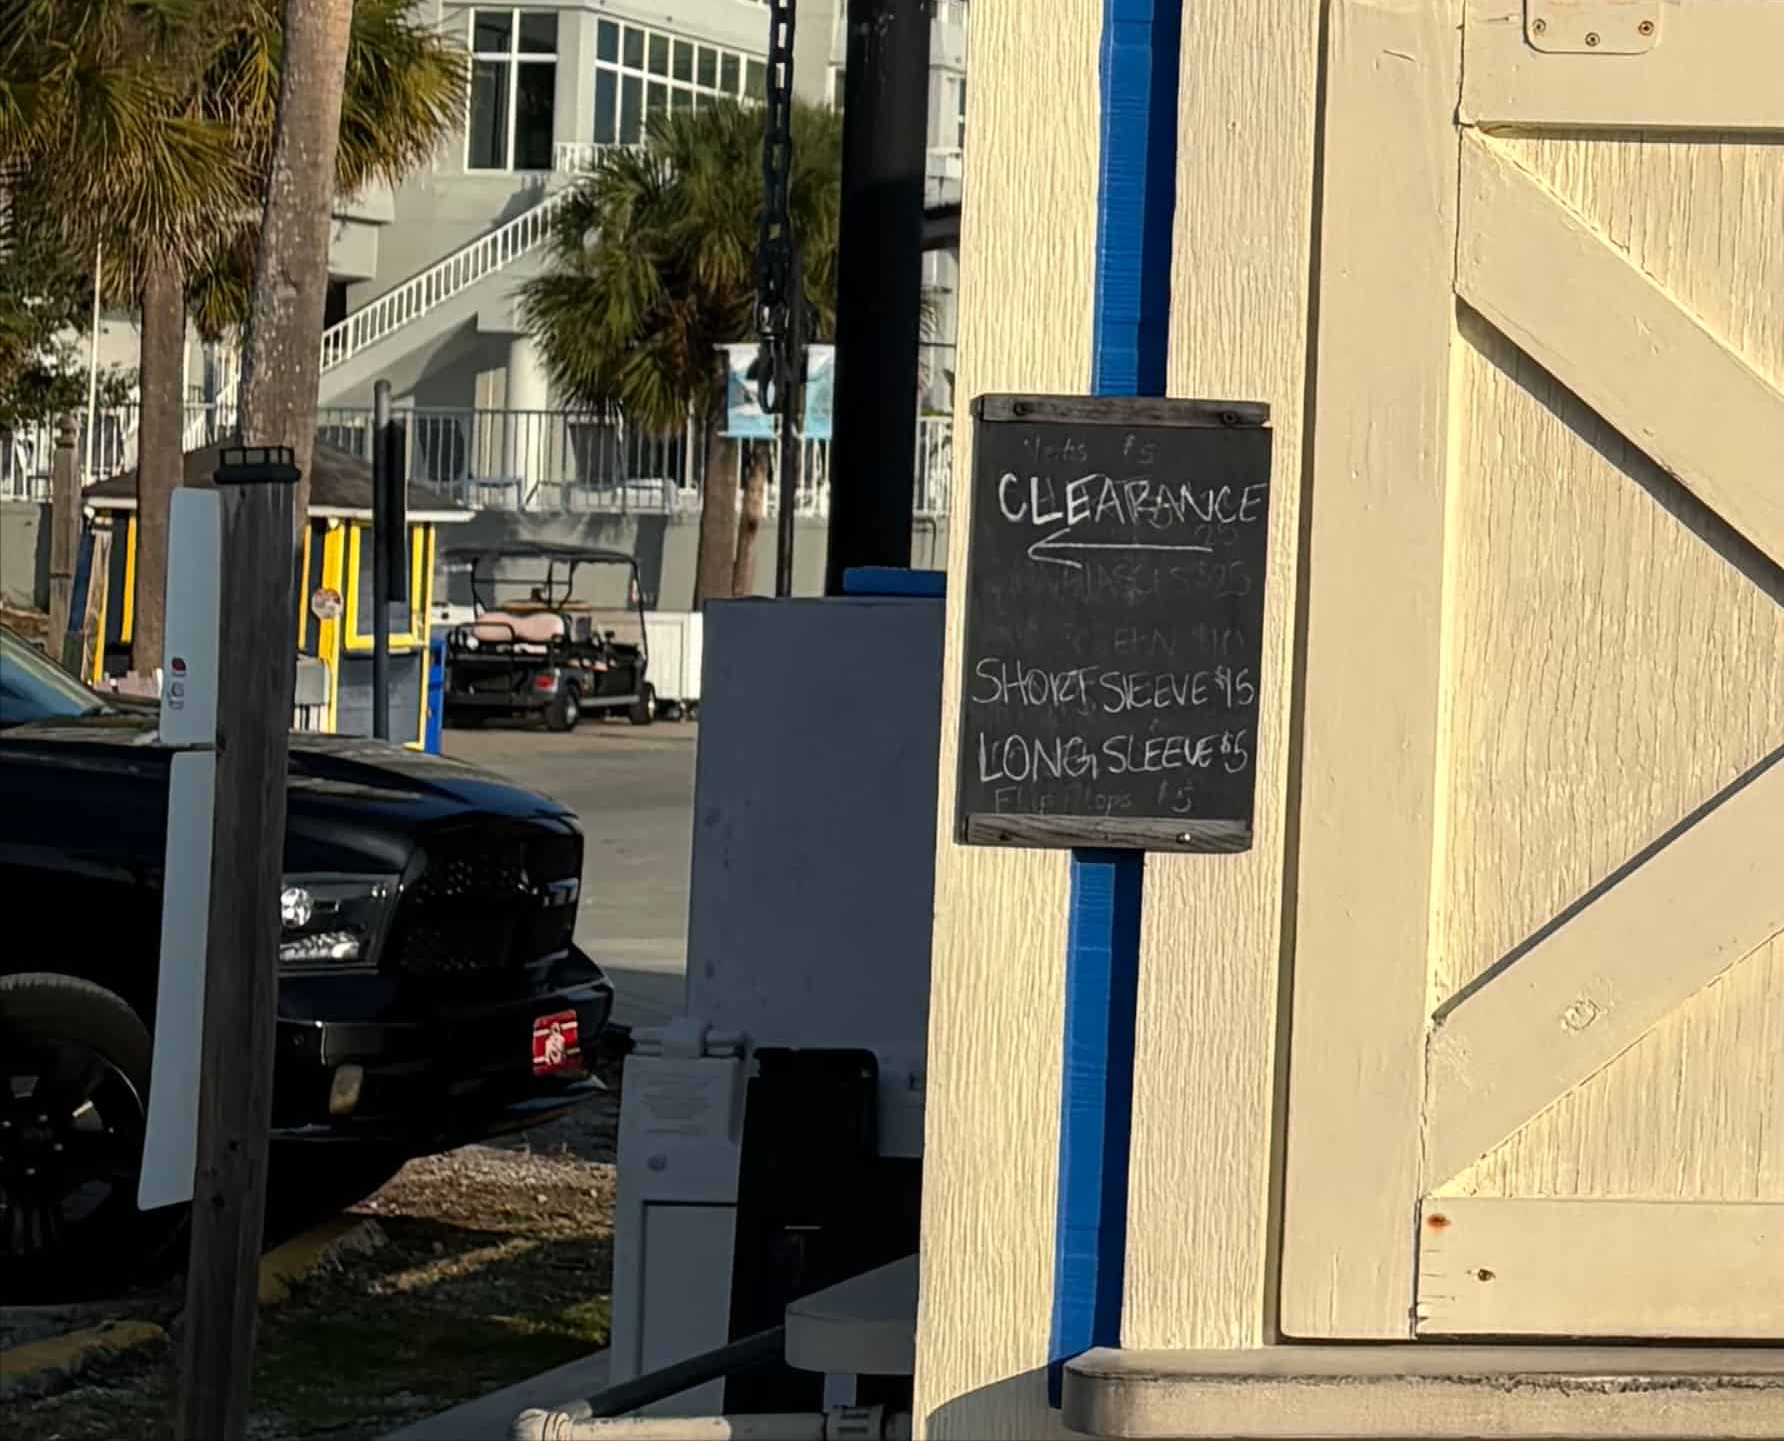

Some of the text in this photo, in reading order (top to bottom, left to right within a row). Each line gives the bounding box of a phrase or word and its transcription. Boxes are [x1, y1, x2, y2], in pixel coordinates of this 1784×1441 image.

[998, 472, 1268, 526] CLEARANCE
[972, 657, 1099, 708] SHORT
[1099, 670, 1209, 714] SLEEVE
[978, 731, 1098, 783] LONG
[1102, 733, 1220, 774] SLEEVE
